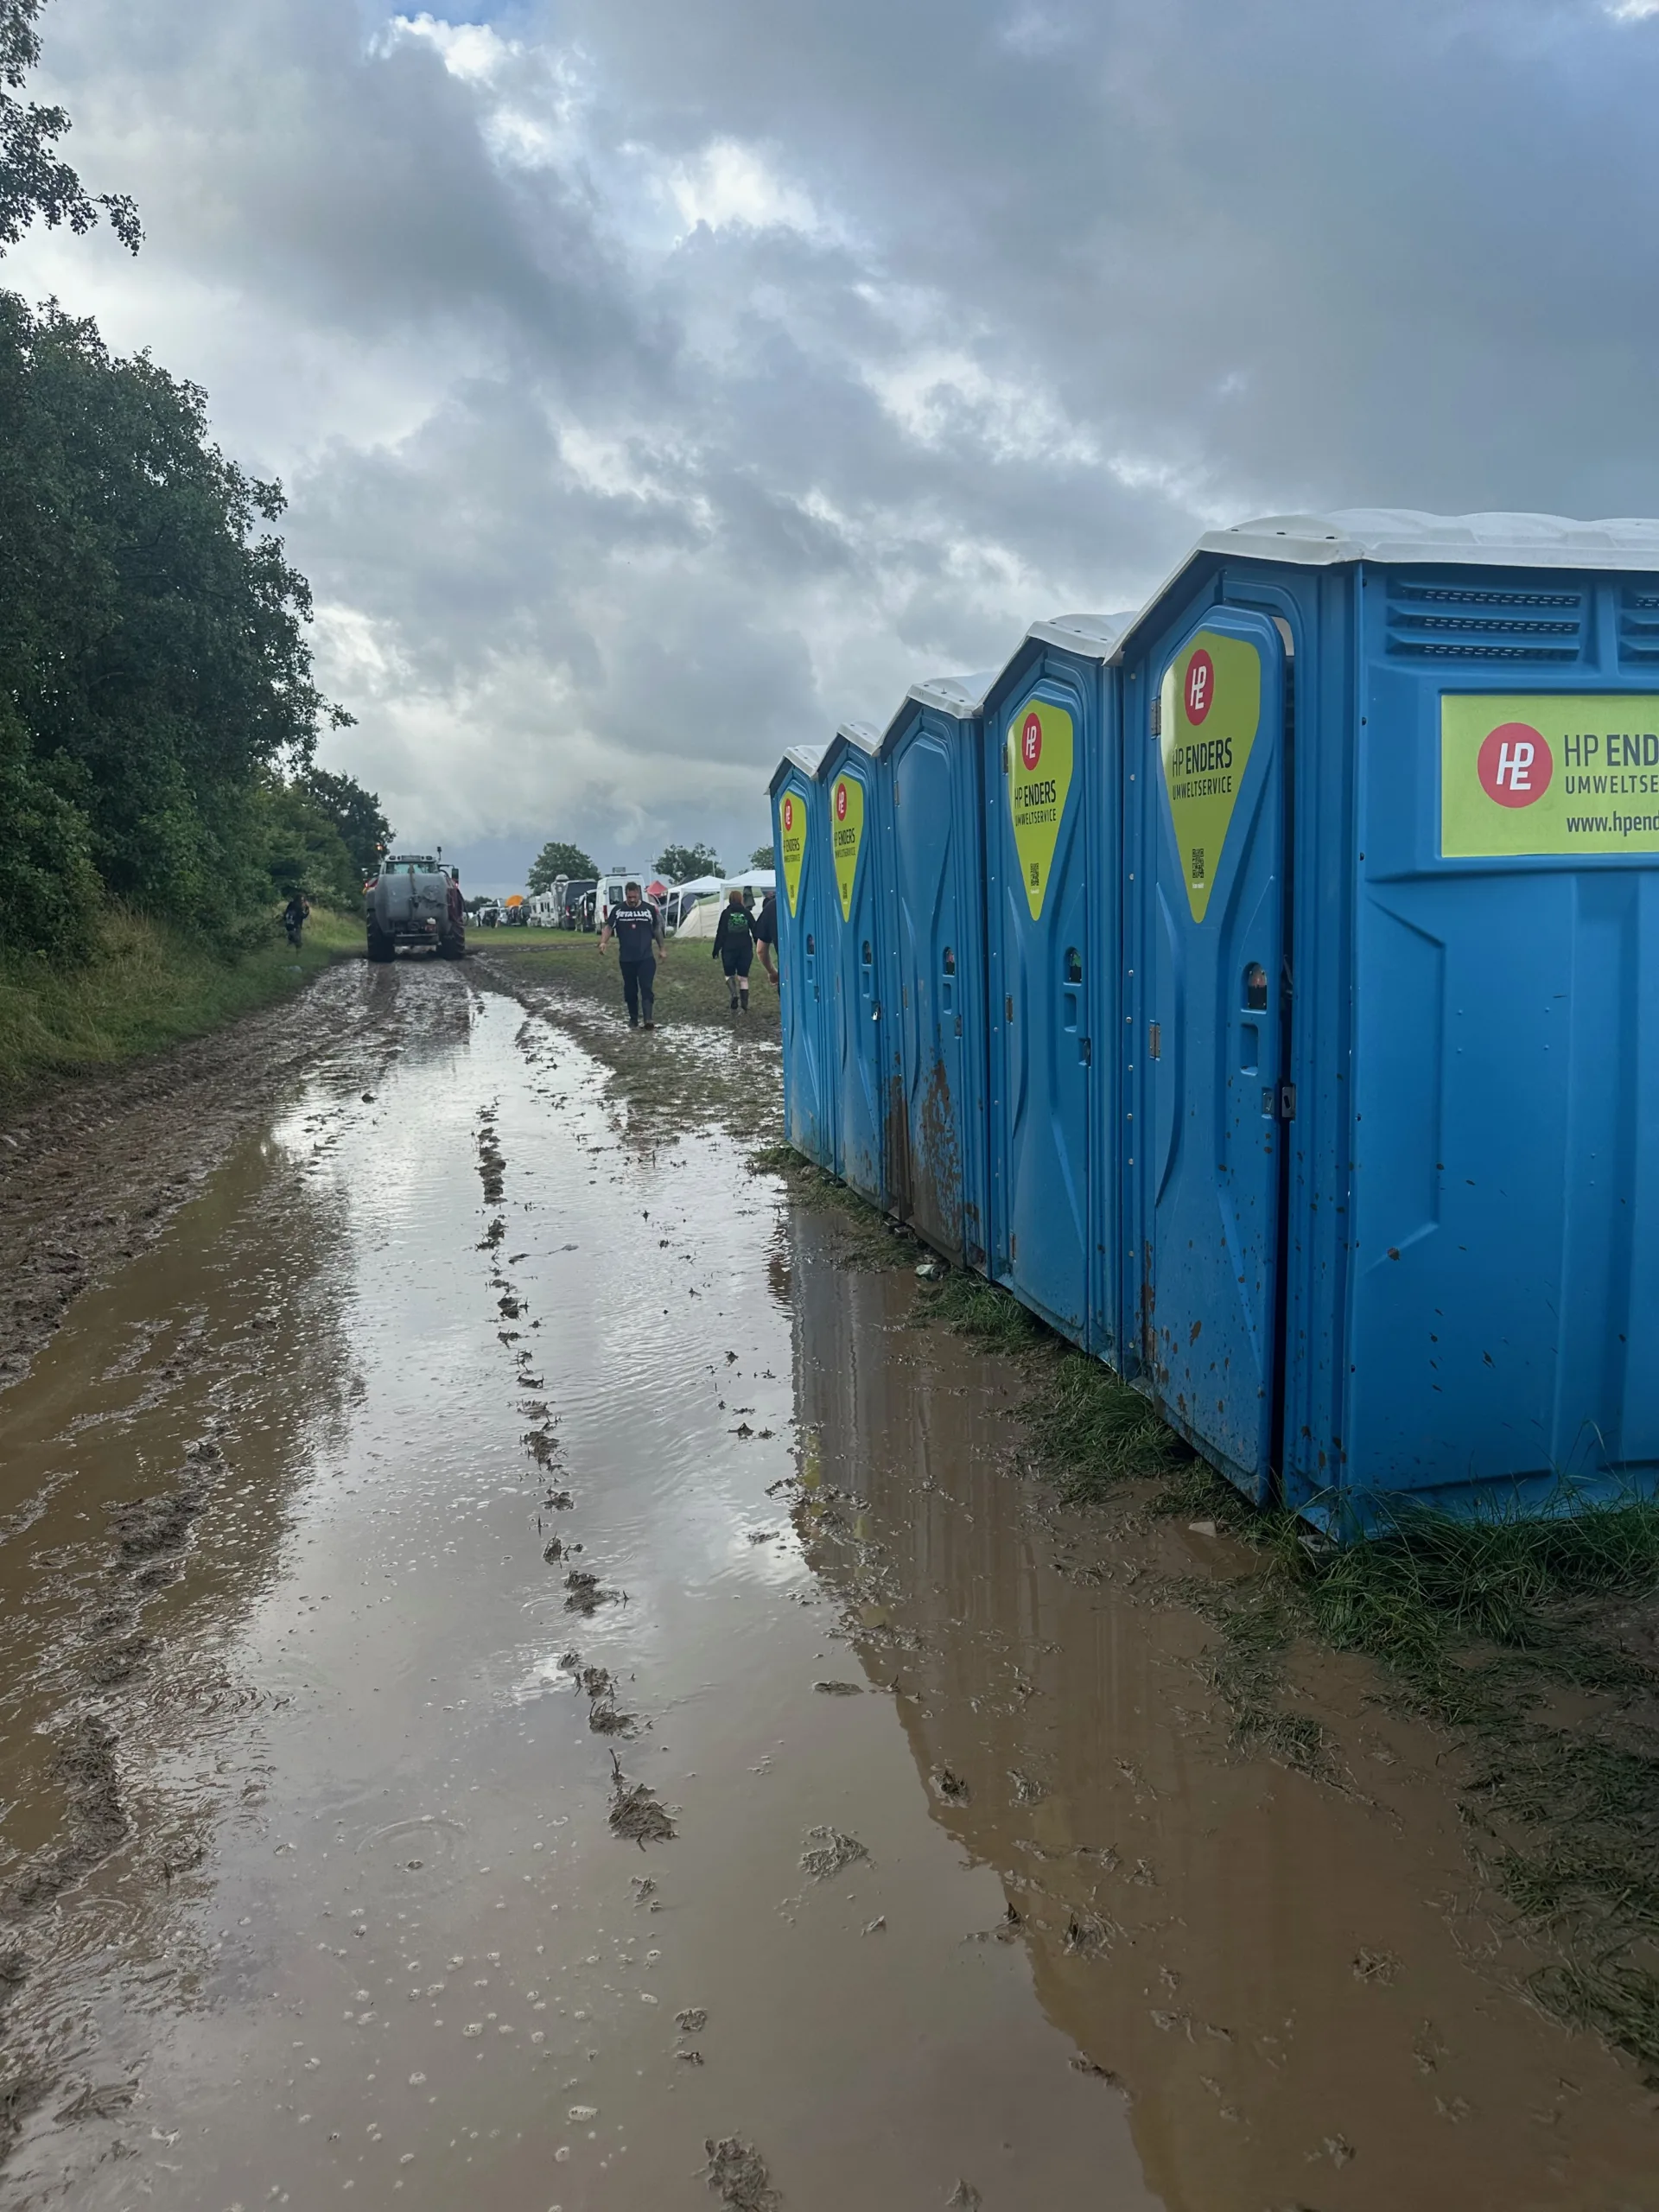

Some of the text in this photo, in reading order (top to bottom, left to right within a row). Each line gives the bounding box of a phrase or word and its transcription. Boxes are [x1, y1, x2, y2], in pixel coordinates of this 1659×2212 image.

[1172, 737, 1232, 778] HP ENDERS
[1564, 734, 1659, 766] HP END
[1014, 779, 1056, 809] HP ENDERS
[1172, 776, 1232, 800] UMWELTSERVICE
[1565, 774, 1659, 794] UMWELTSE
[1015, 809, 1056, 826] UMWELTSERVICE
